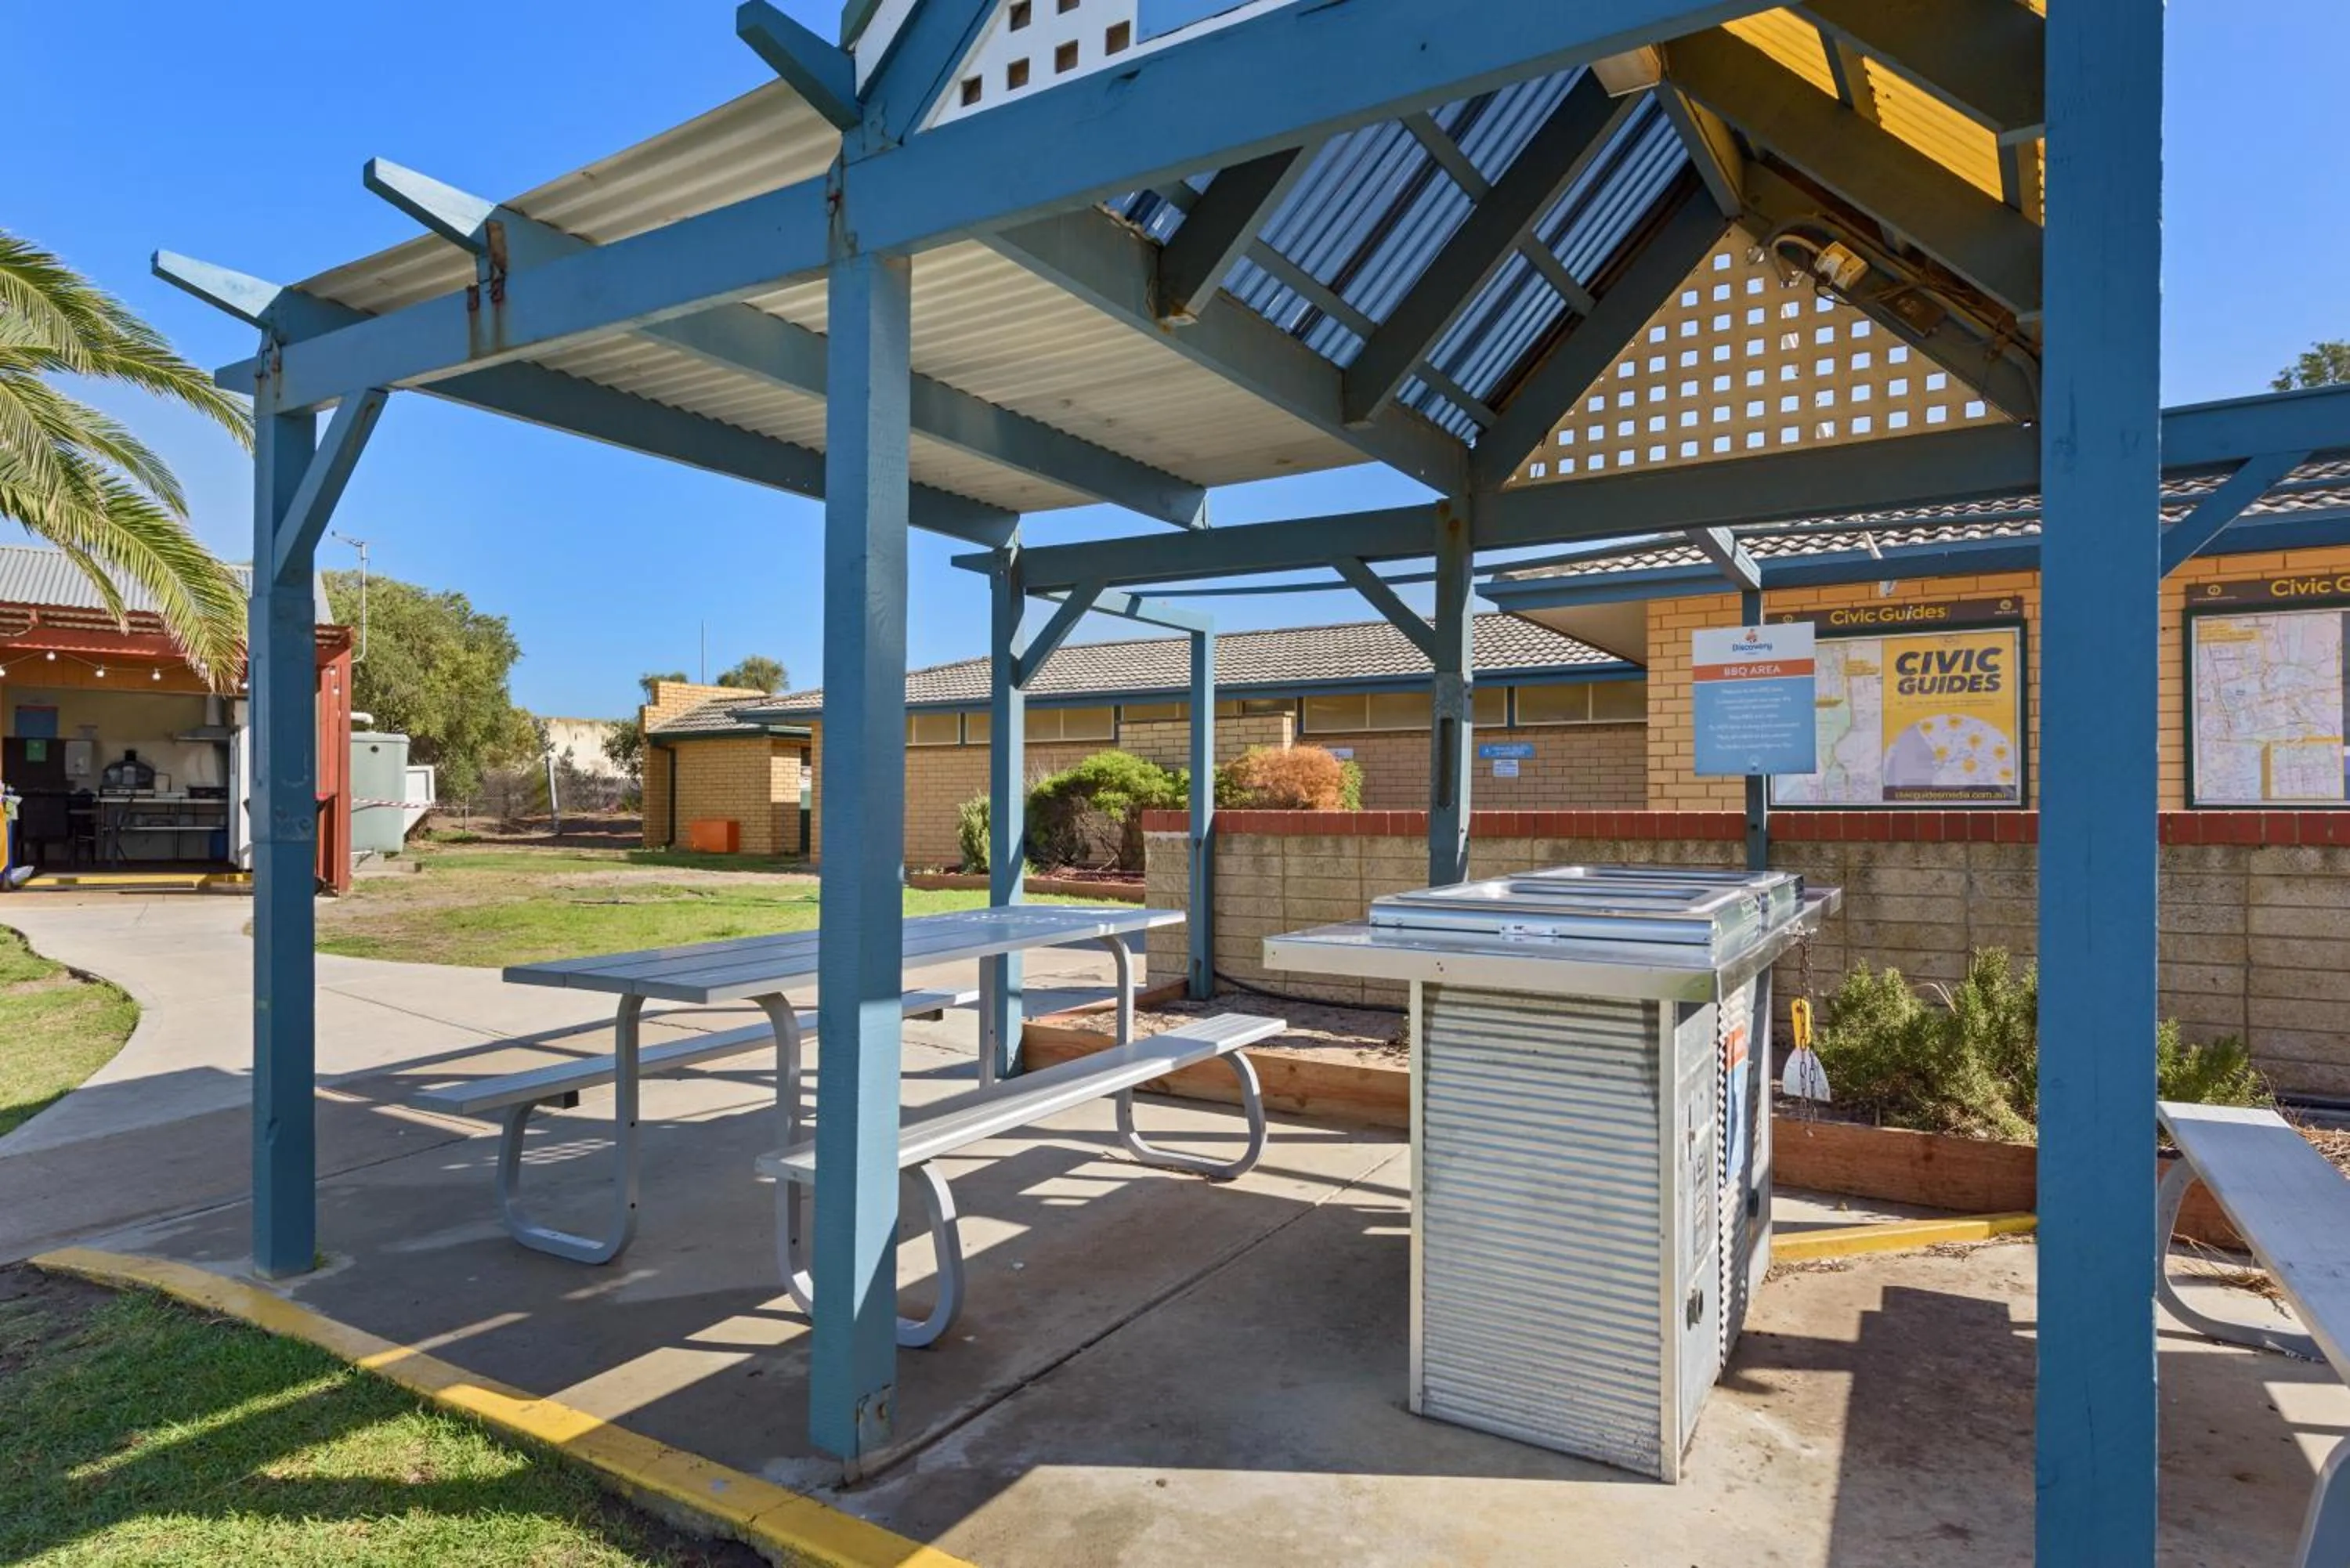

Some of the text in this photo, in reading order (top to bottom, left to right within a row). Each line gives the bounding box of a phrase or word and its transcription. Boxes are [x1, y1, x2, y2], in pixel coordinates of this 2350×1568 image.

[2271, 577, 2332, 596] Civic
[1829, 605, 1947, 625] Civic Guides
[1724, 664, 1781, 677] BBQ AREA
[1895, 646, 2004, 676] CIVIC
[1897, 673, 2002, 696] GUIDES
